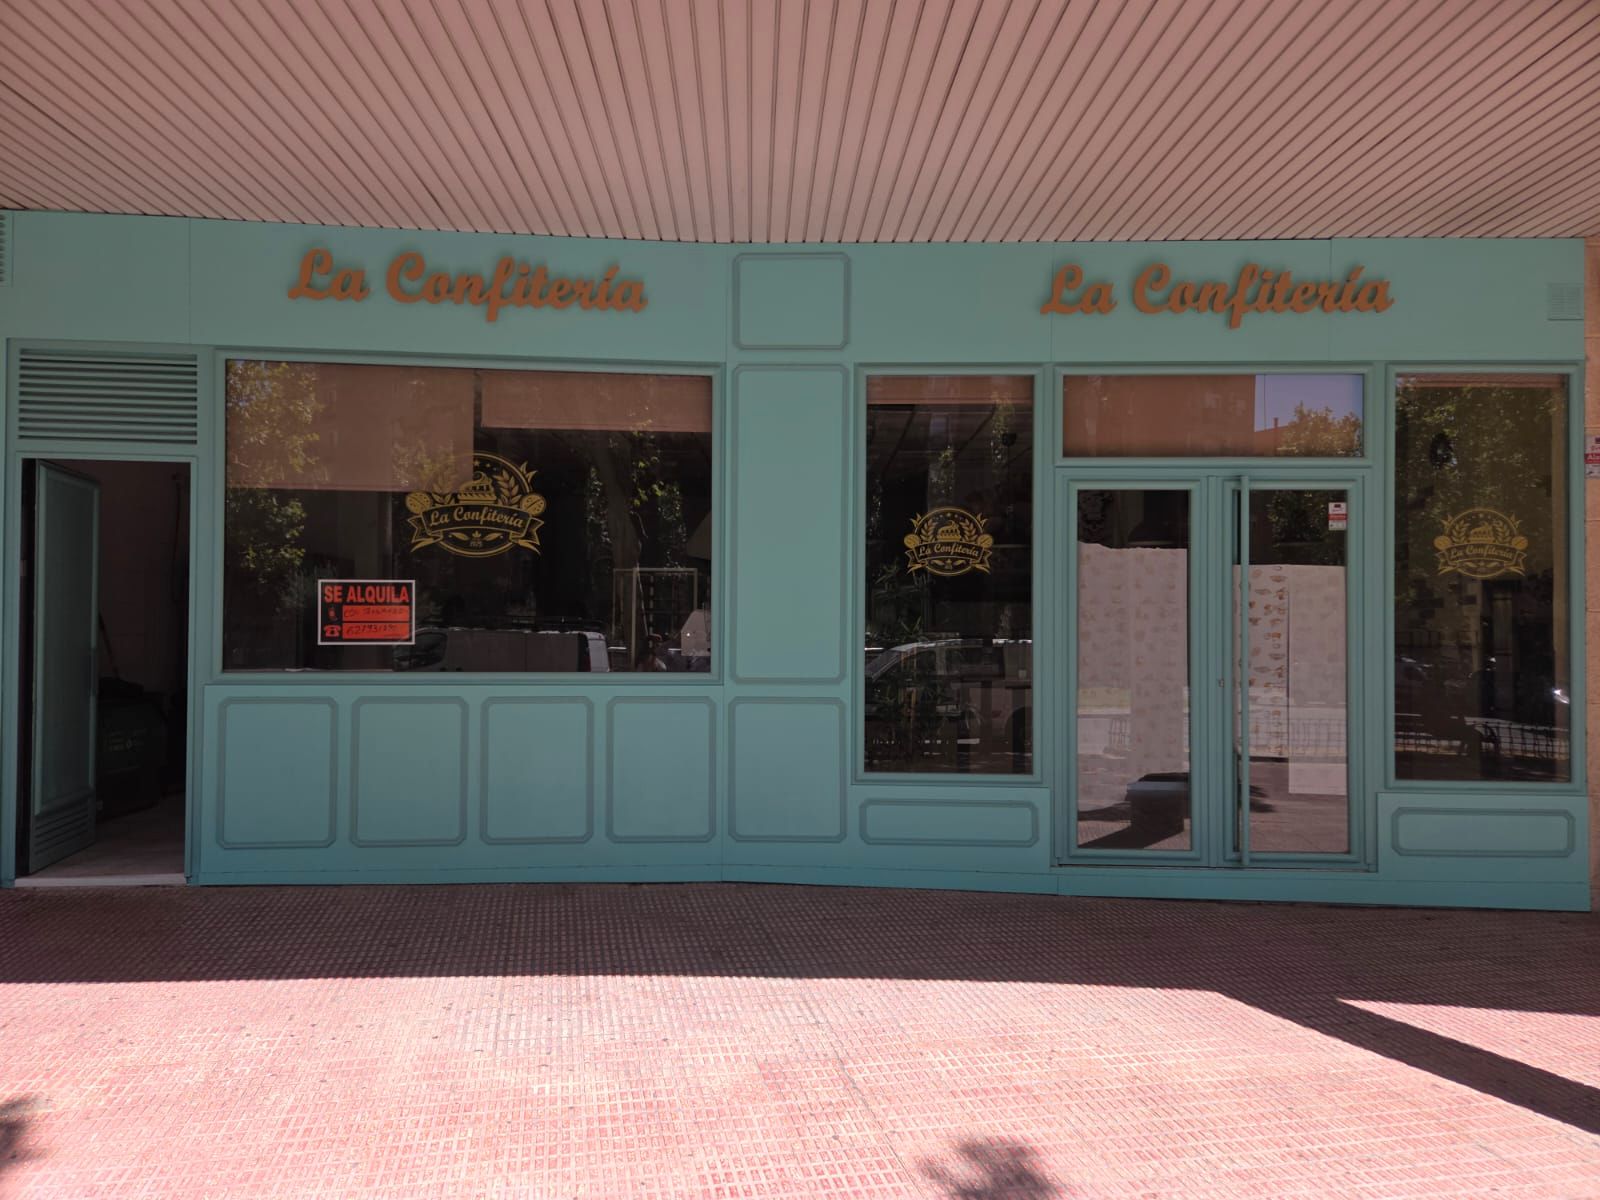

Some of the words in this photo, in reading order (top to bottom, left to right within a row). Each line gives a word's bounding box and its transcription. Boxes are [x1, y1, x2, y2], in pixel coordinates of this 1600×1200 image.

[288, 247, 370, 302] La
[386, 251, 649, 323] Confitería
[1040, 263, 1118, 315] La
[1133, 262, 1394, 330] Confitería
[430, 510, 450, 527] La
[453, 506, 524, 528] Confitería
[918, 545, 931, 557] La
[324, 584, 343, 603] SE
[346, 584, 409, 603] ALQUILA
